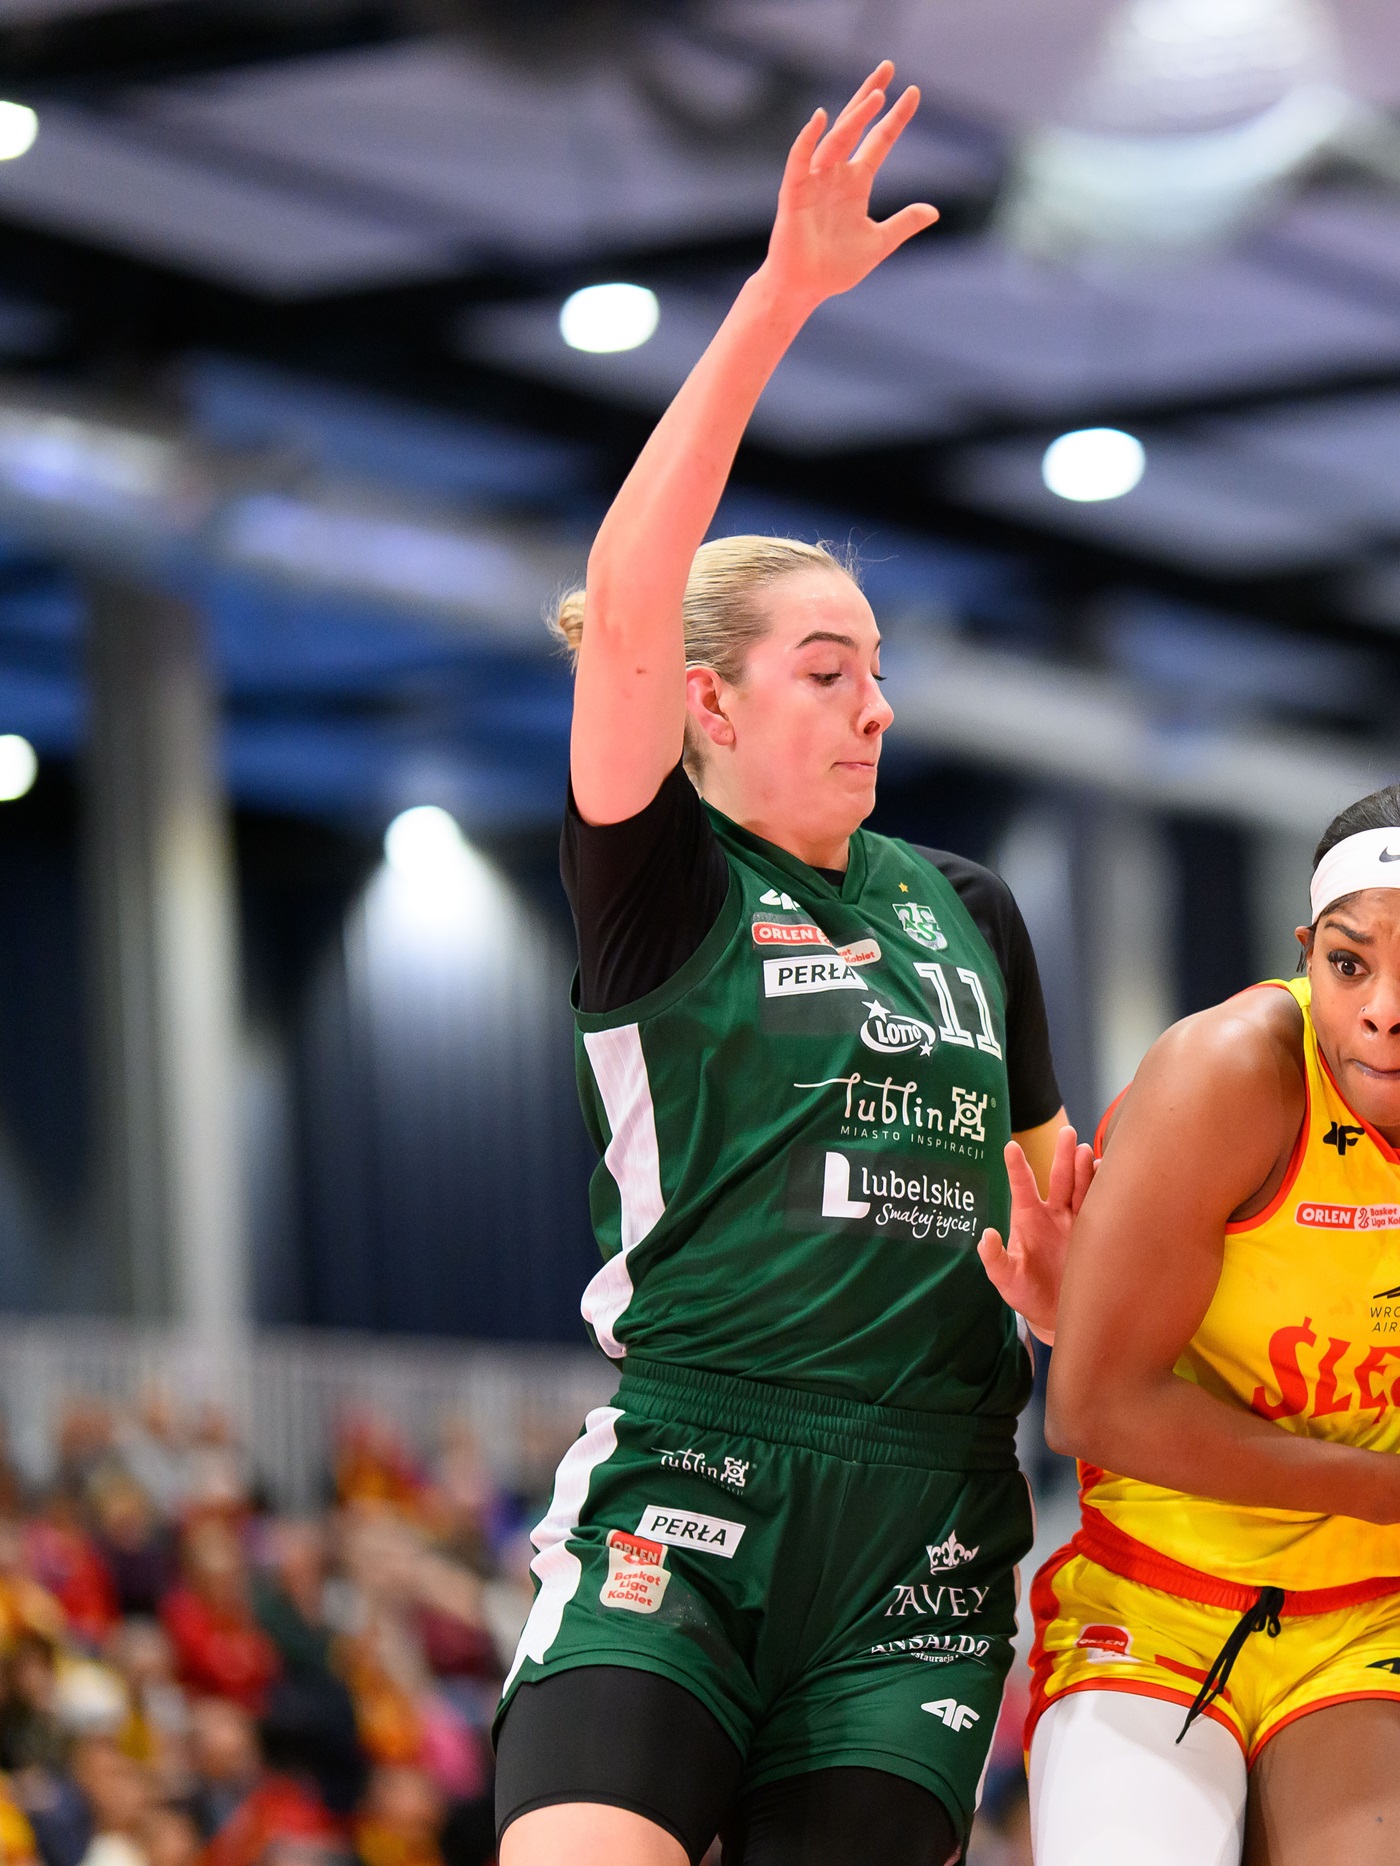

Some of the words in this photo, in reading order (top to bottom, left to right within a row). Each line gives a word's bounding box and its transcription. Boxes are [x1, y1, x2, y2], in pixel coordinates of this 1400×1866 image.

[759, 927, 813, 941] ORLEN
[778, 963, 857, 987] PERŁA
[913, 962, 1003, 1061] 11
[875, 1020, 922, 1045] LOTTO
[840, 1125, 900, 1141] MIASTO
[910, 1133, 985, 1160] INSPIRACJI
[875, 1203, 937, 1239] Smakuj
[935, 1211, 978, 1239] życie!
[1302, 1207, 1352, 1225] ORLEN
[1370, 1207, 1397, 1217] Basket
[650, 1515, 727, 1546] PERŁA
[612, 1541, 658, 1563] ORLEN
[614, 1571, 661, 1586] Basket
[619, 1581, 648, 1594] Liga
[921, 1698, 980, 1732] 4F
